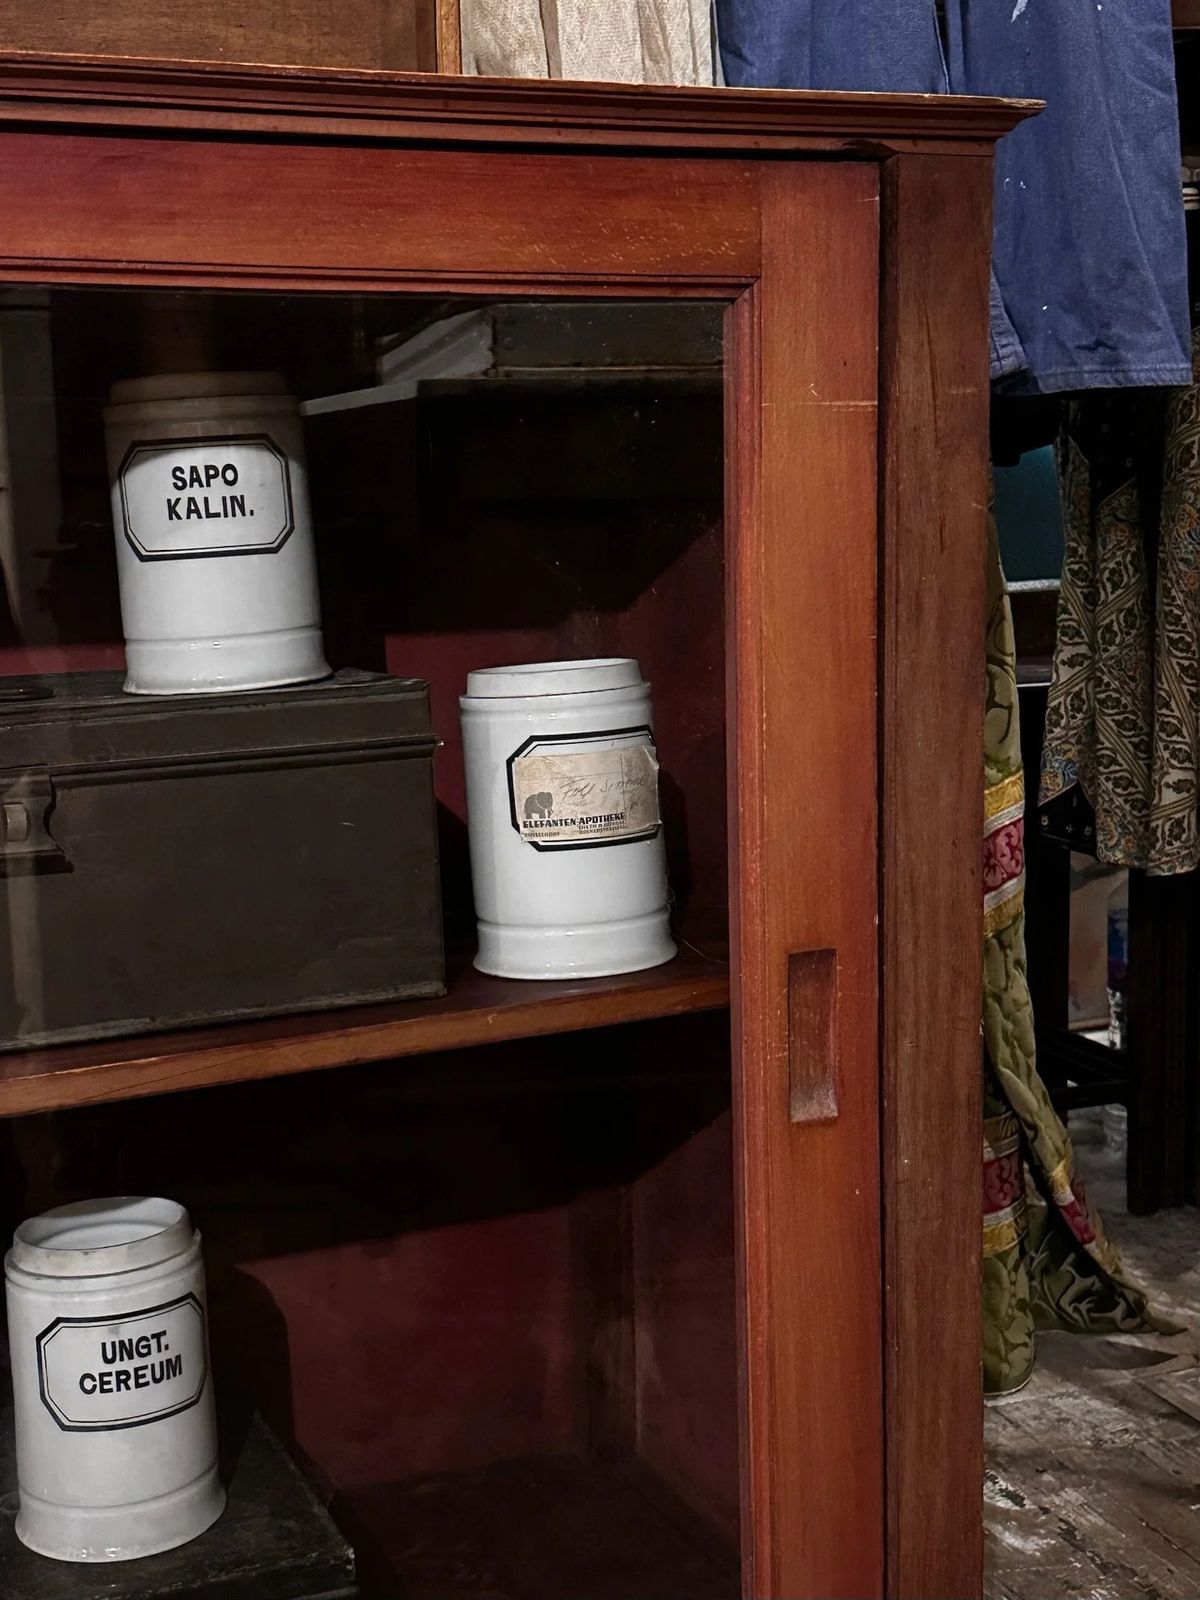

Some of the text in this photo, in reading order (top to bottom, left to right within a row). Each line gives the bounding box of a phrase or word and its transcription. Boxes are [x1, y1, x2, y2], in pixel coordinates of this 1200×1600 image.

[171, 463, 239, 491] SAPO
[166, 494, 254, 521] KALIN.
[101, 1329, 169, 1365] UNGT.
[79, 1354, 183, 1395] CEREUM
